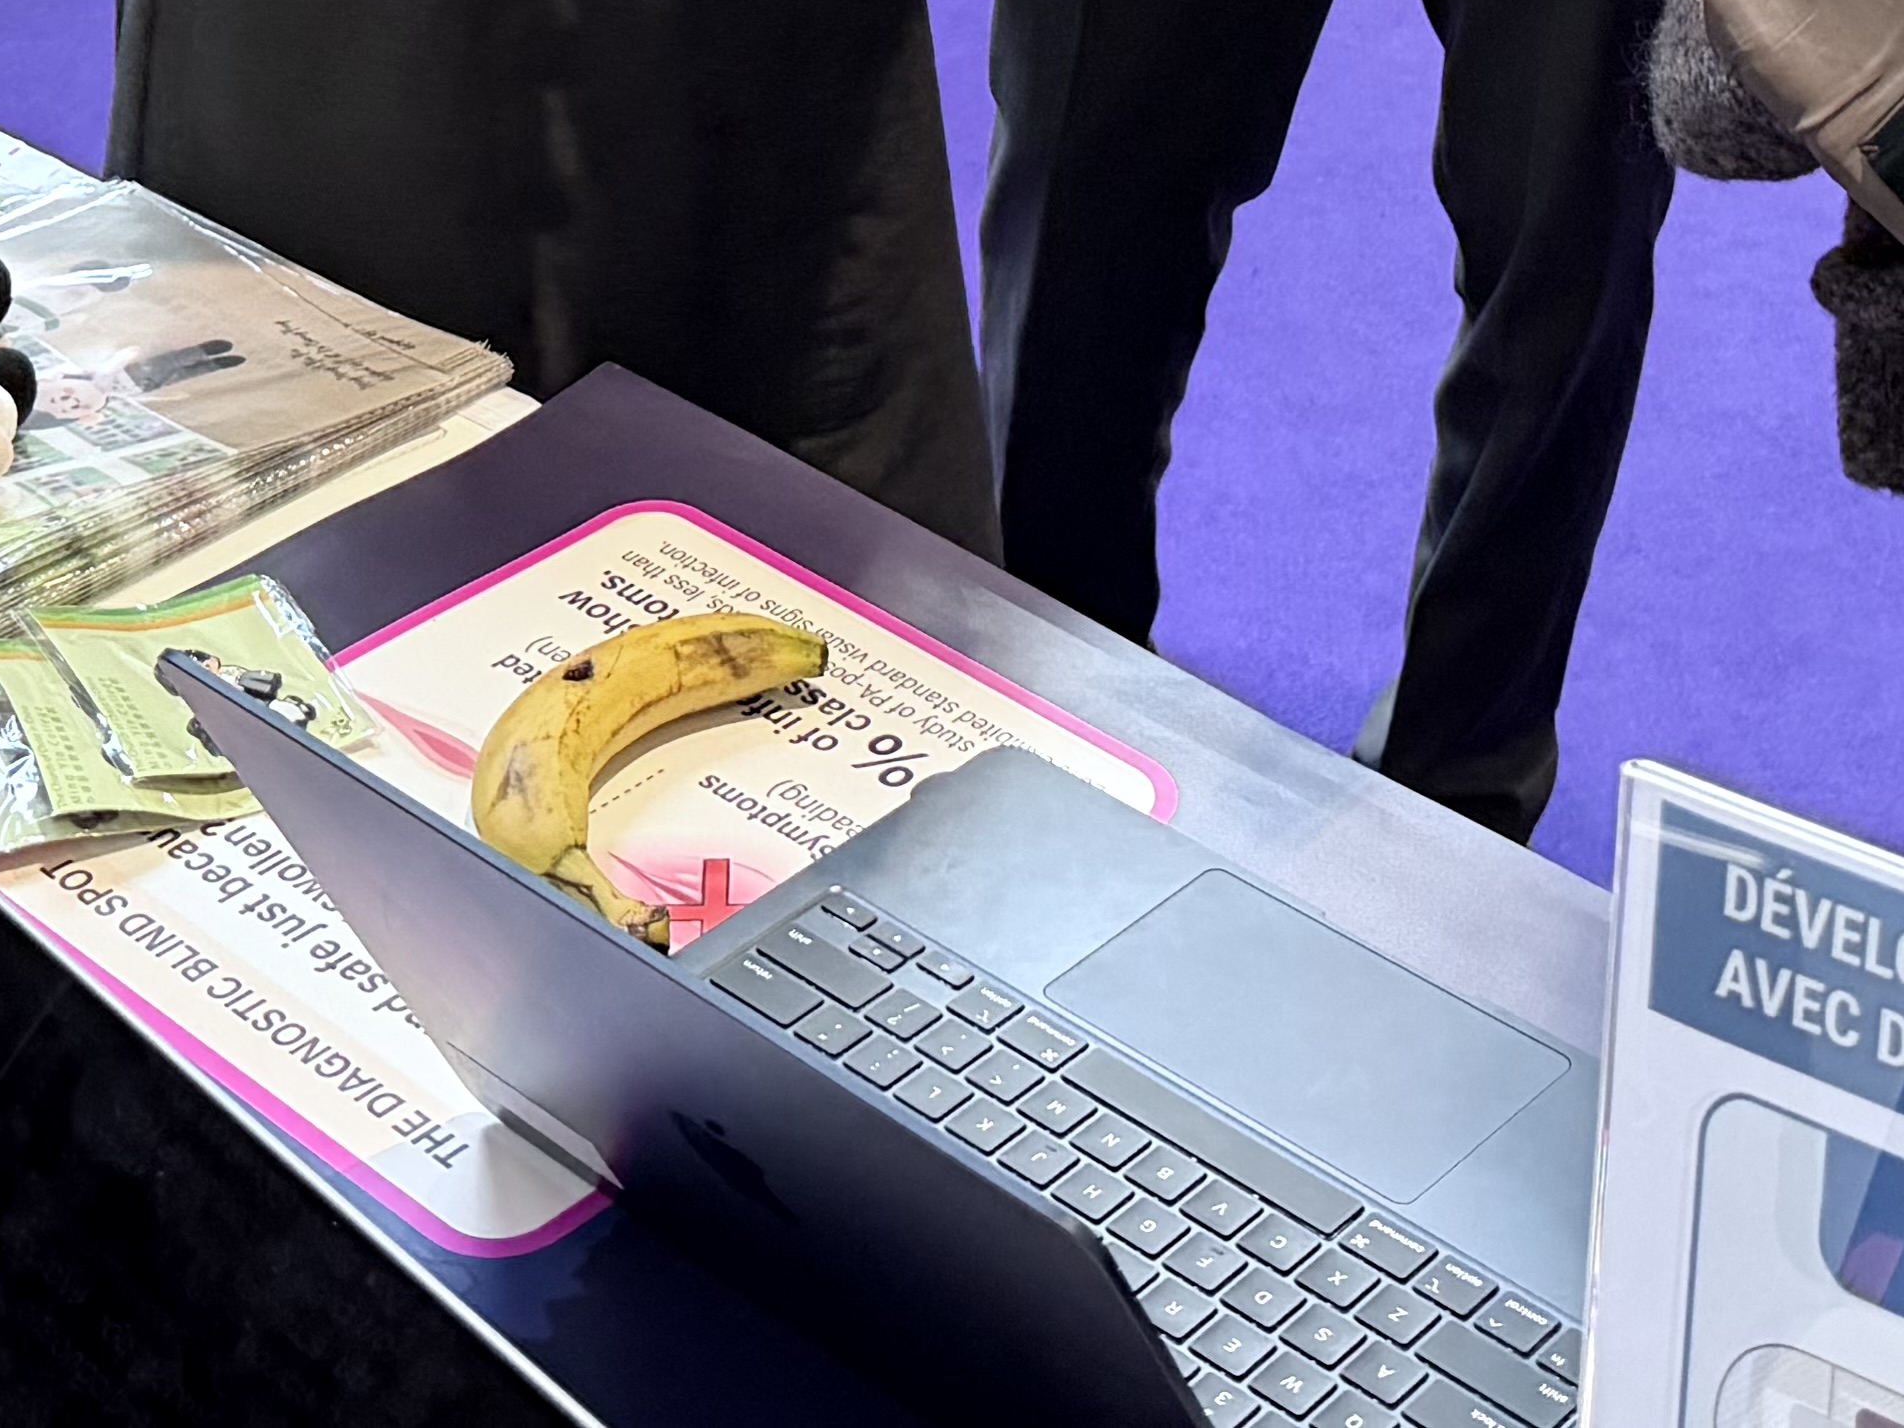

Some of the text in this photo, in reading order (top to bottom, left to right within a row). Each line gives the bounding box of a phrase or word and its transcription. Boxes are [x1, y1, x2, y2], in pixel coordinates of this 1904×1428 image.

[659, 541, 740, 593] infection.
[729, 587, 761, 602] of
[621, 550, 974, 752] study of less than
[860, 659, 959, 718] standard
[788, 727, 838, 751] of
[698, 775, 839, 862] Symptoms
[238, 893, 395, 992] safe just
[743, 956, 773, 981] return
[37, 857, 468, 1168] THE DIAGNOSTIC BLIND SPOT
[1715, 948, 1861, 1049] AVEC
[1026, 1015, 1077, 1050] command
